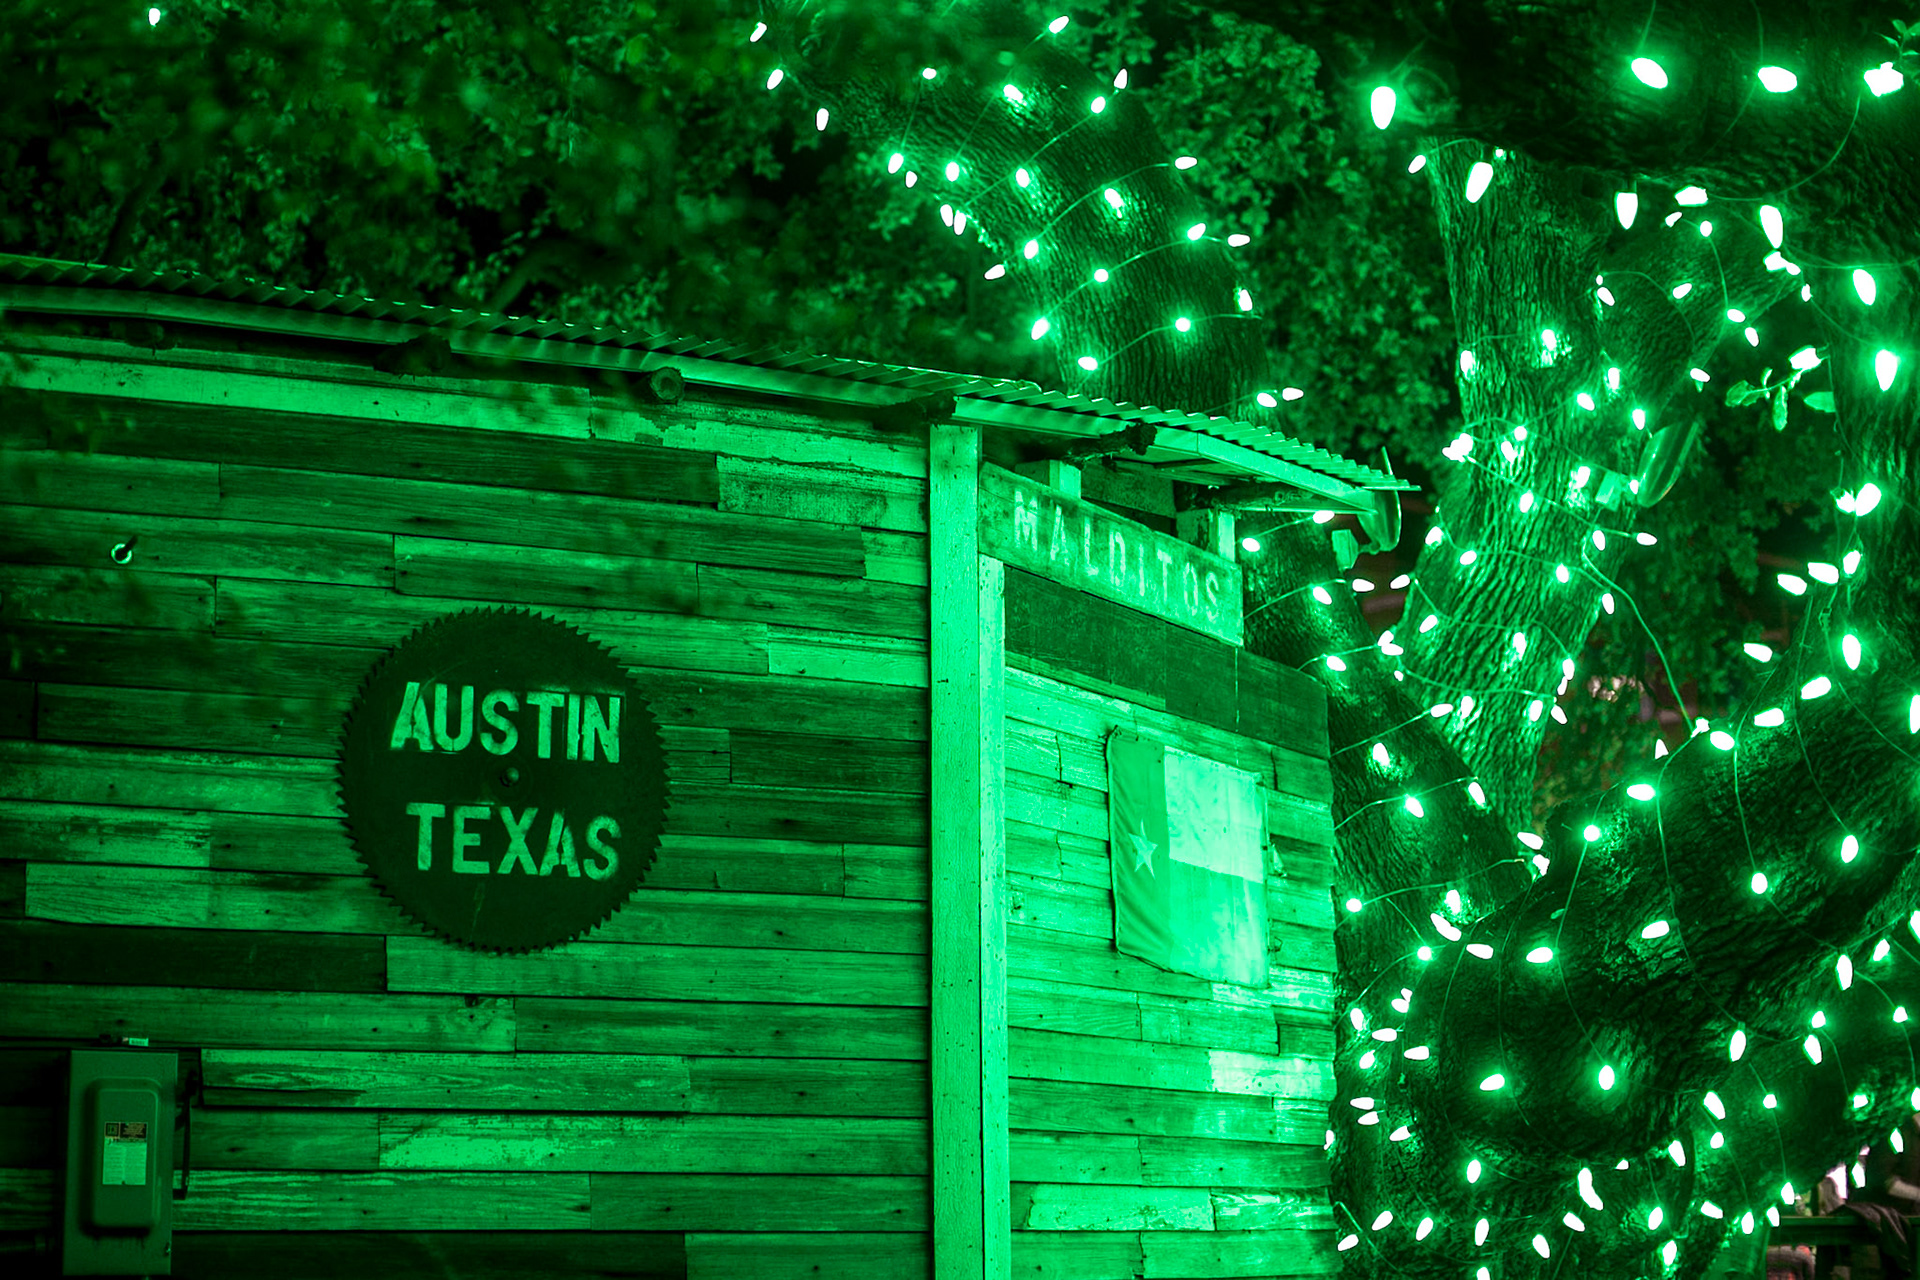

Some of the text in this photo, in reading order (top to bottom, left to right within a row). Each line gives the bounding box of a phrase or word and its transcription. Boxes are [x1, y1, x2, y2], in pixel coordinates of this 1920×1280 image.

[1014, 490, 1220, 623] MALDITOS
[390, 682, 621, 764] AUSTIN
[405, 802, 622, 881] TEXAS
